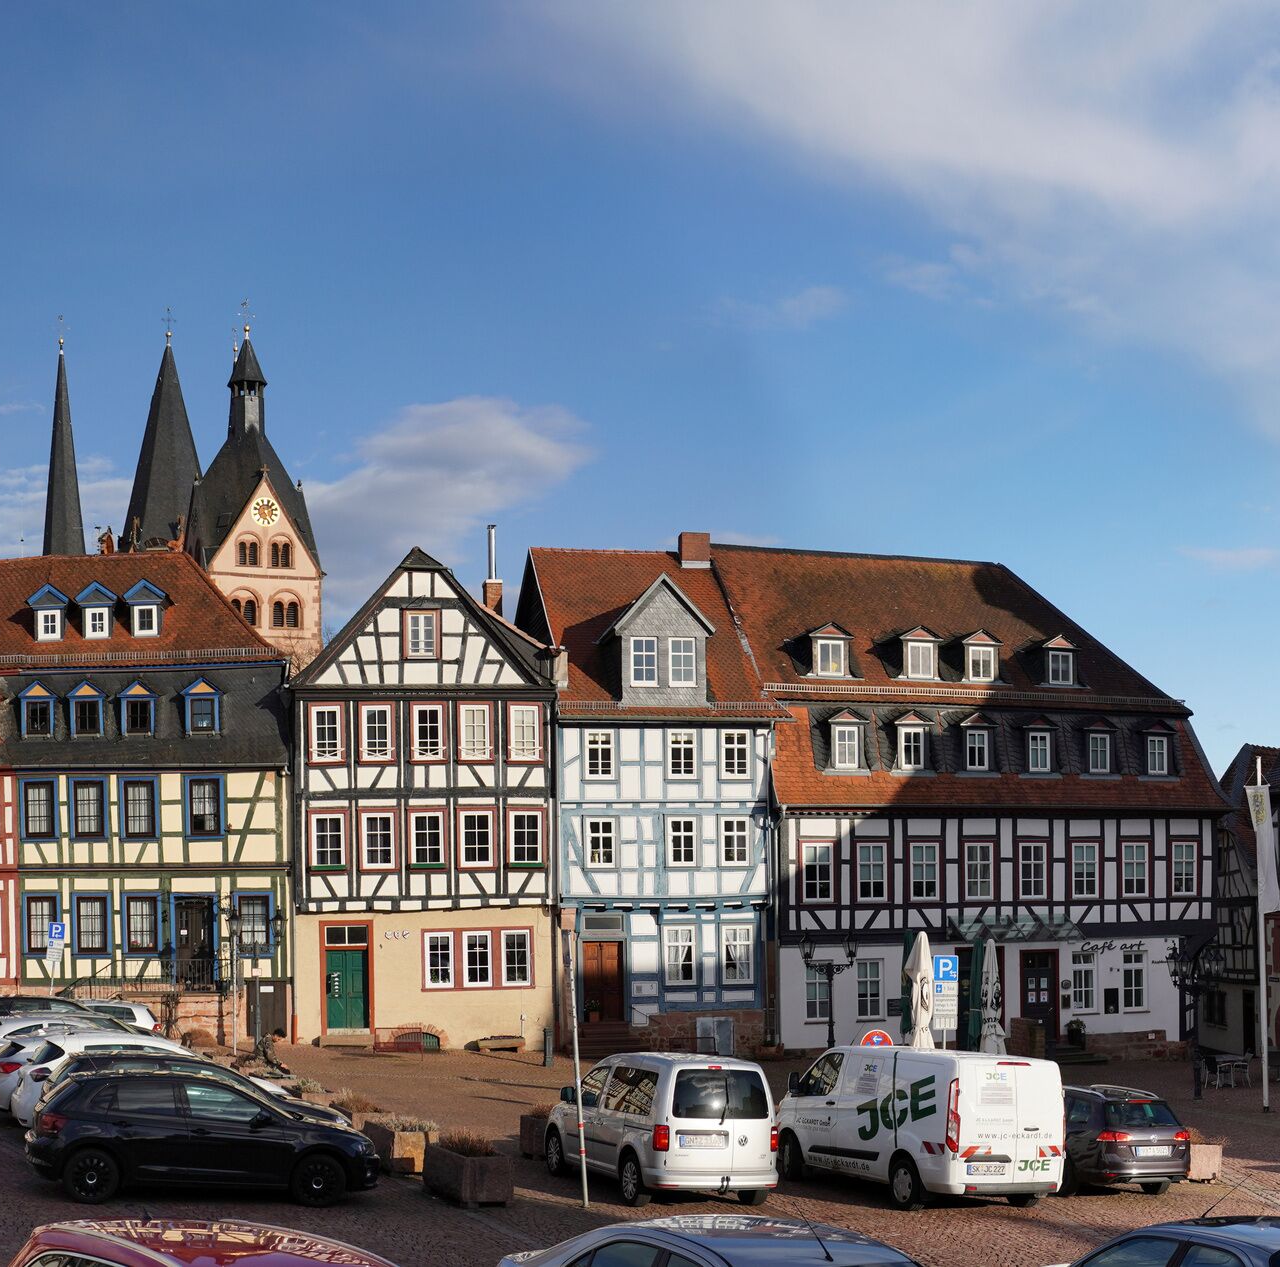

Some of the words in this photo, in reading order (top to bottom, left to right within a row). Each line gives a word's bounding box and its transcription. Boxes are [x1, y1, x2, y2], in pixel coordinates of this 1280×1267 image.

[1081, 940, 1117, 954] Café
[1120, 940, 1146, 950] art
[939, 959, 953, 978] P
[864, 1064, 878, 1072] JCE
[986, 1072, 1007, 1080] JCE
[856, 1075, 937, 1141] JCE
[977, 1132, 1053, 1140] www.jc-eckardt.de
[808, 1155, 870, 1171] www.jc-eckardt.de
[972, 1165, 980, 1173] SK
[984, 1165, 993, 1173] JC
[993, 1165, 1005, 1173] 227
[1018, 1159, 1051, 1171] JCE
